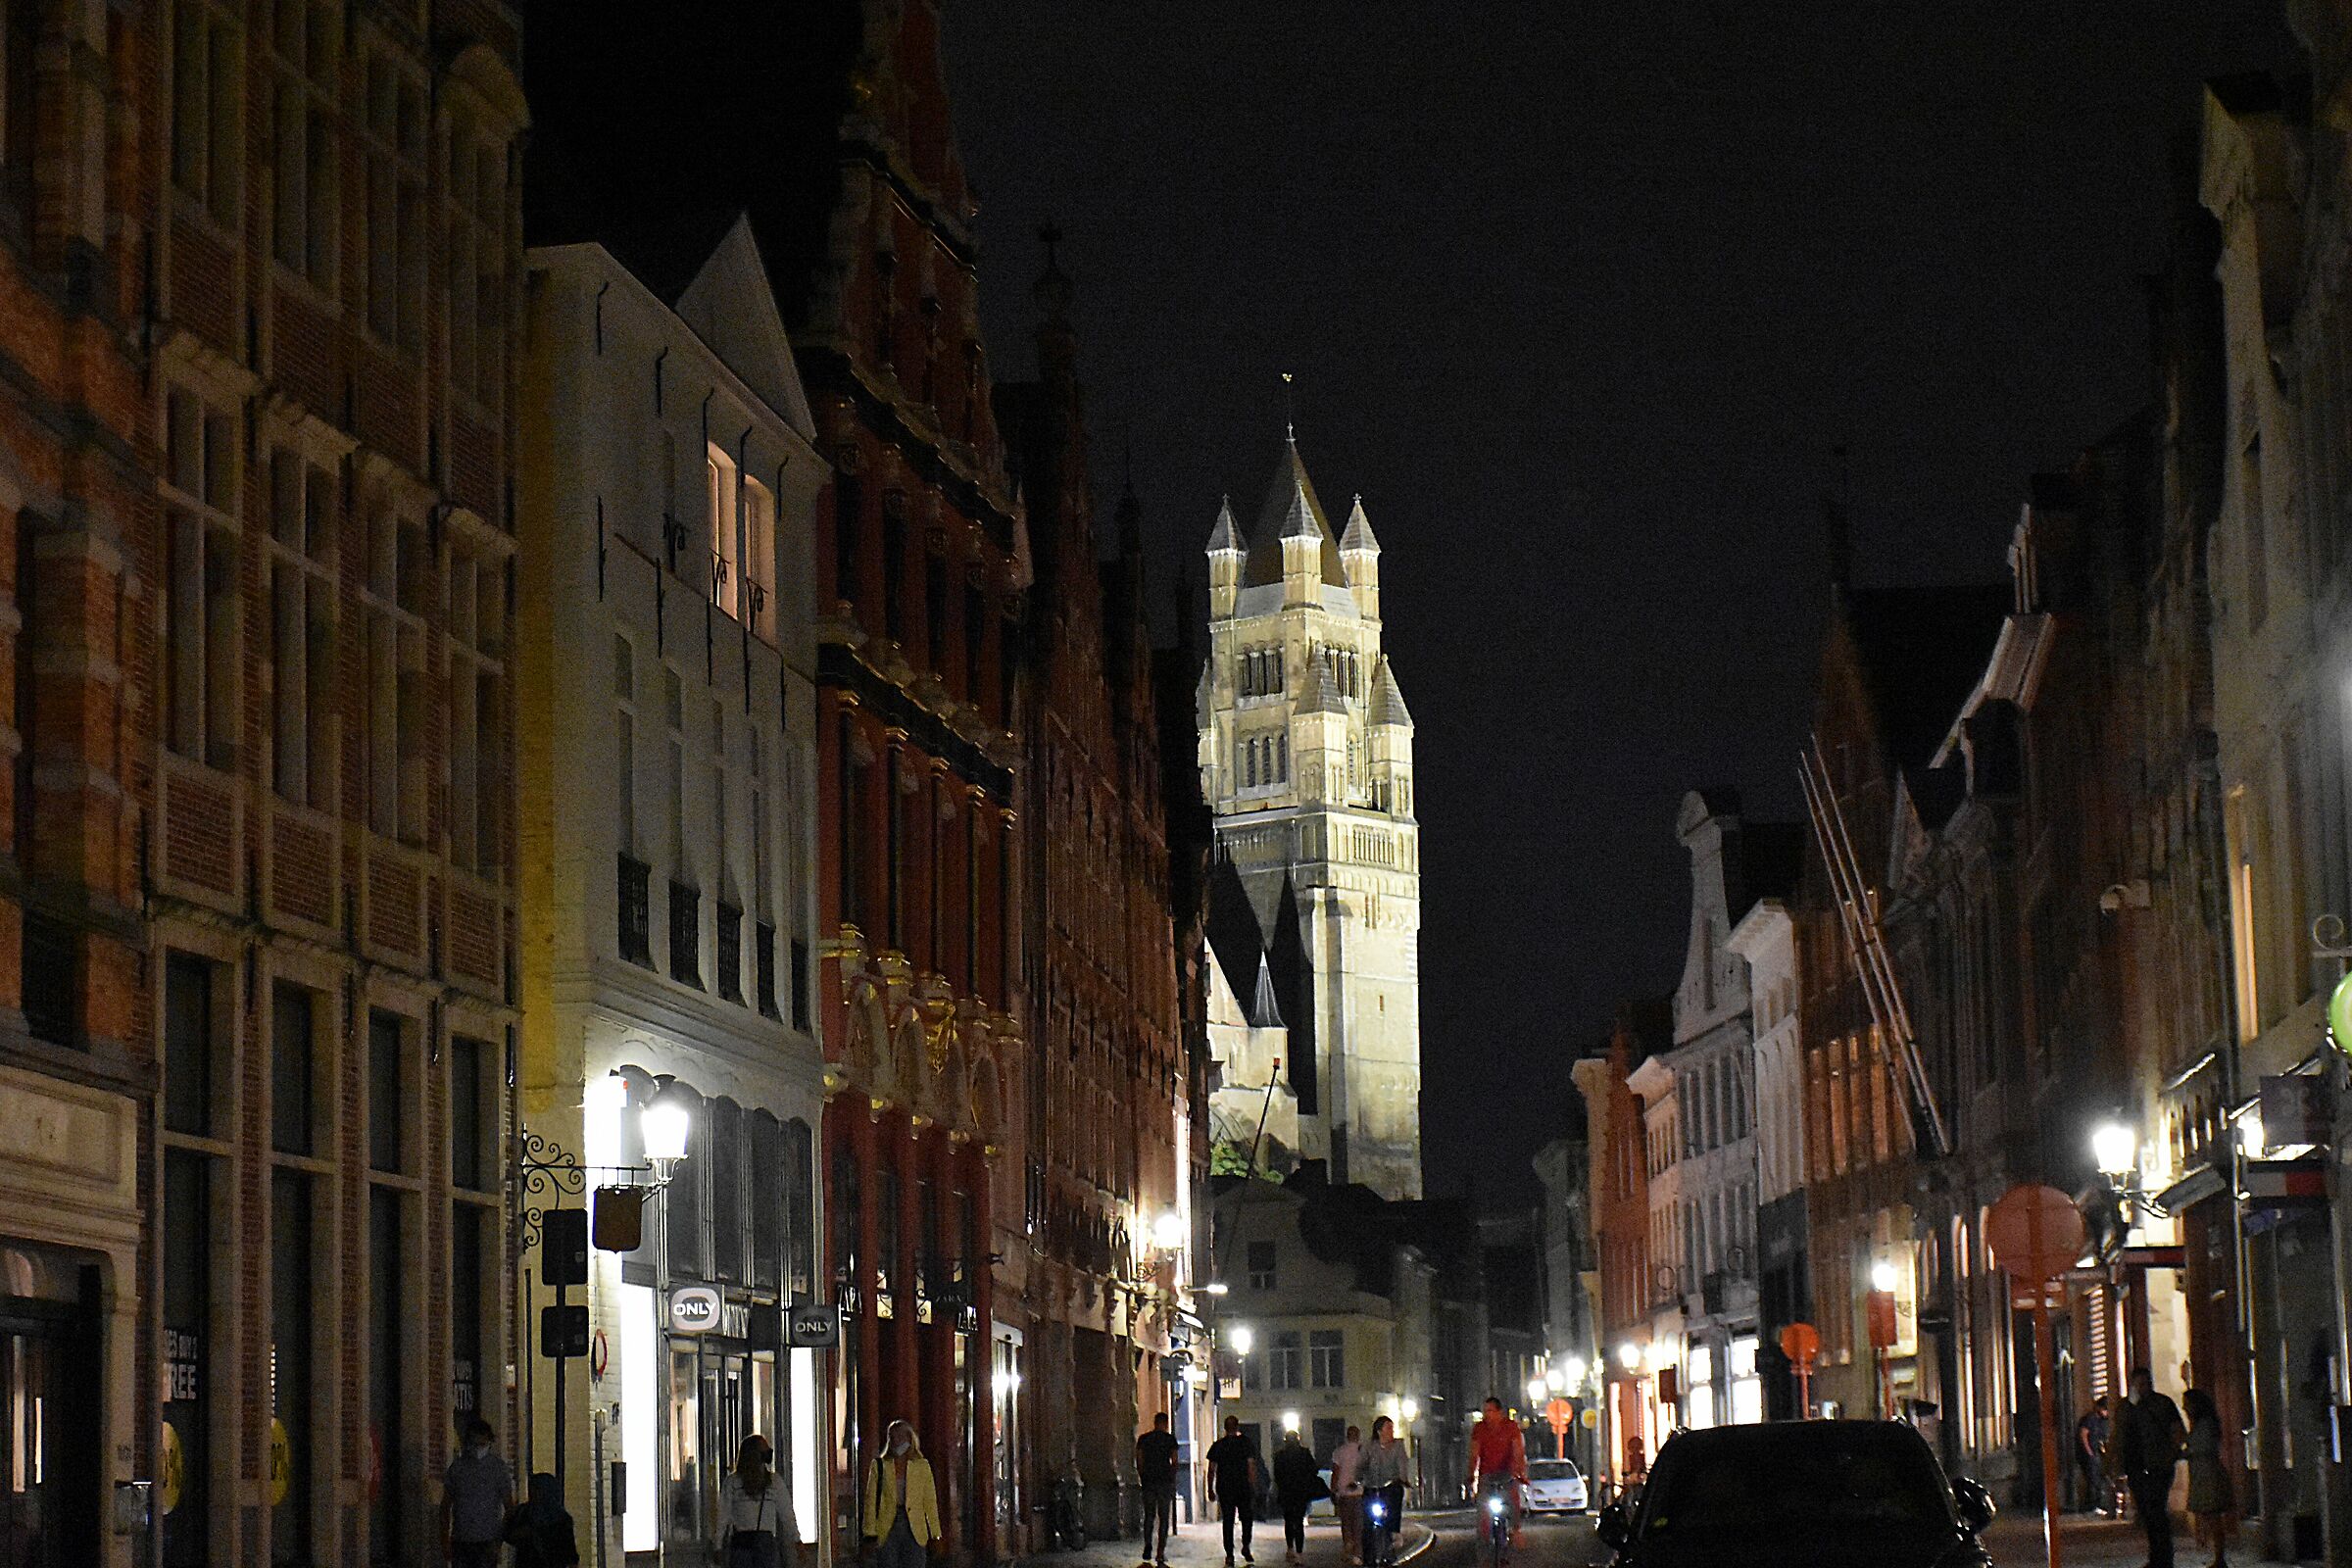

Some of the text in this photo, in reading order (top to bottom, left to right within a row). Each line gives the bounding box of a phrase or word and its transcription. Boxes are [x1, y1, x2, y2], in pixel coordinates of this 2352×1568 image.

[935, 1294, 962, 1302] ZARA
[673, 1301, 716, 1316] ONLY
[795, 1320, 832, 1334] ONLY
